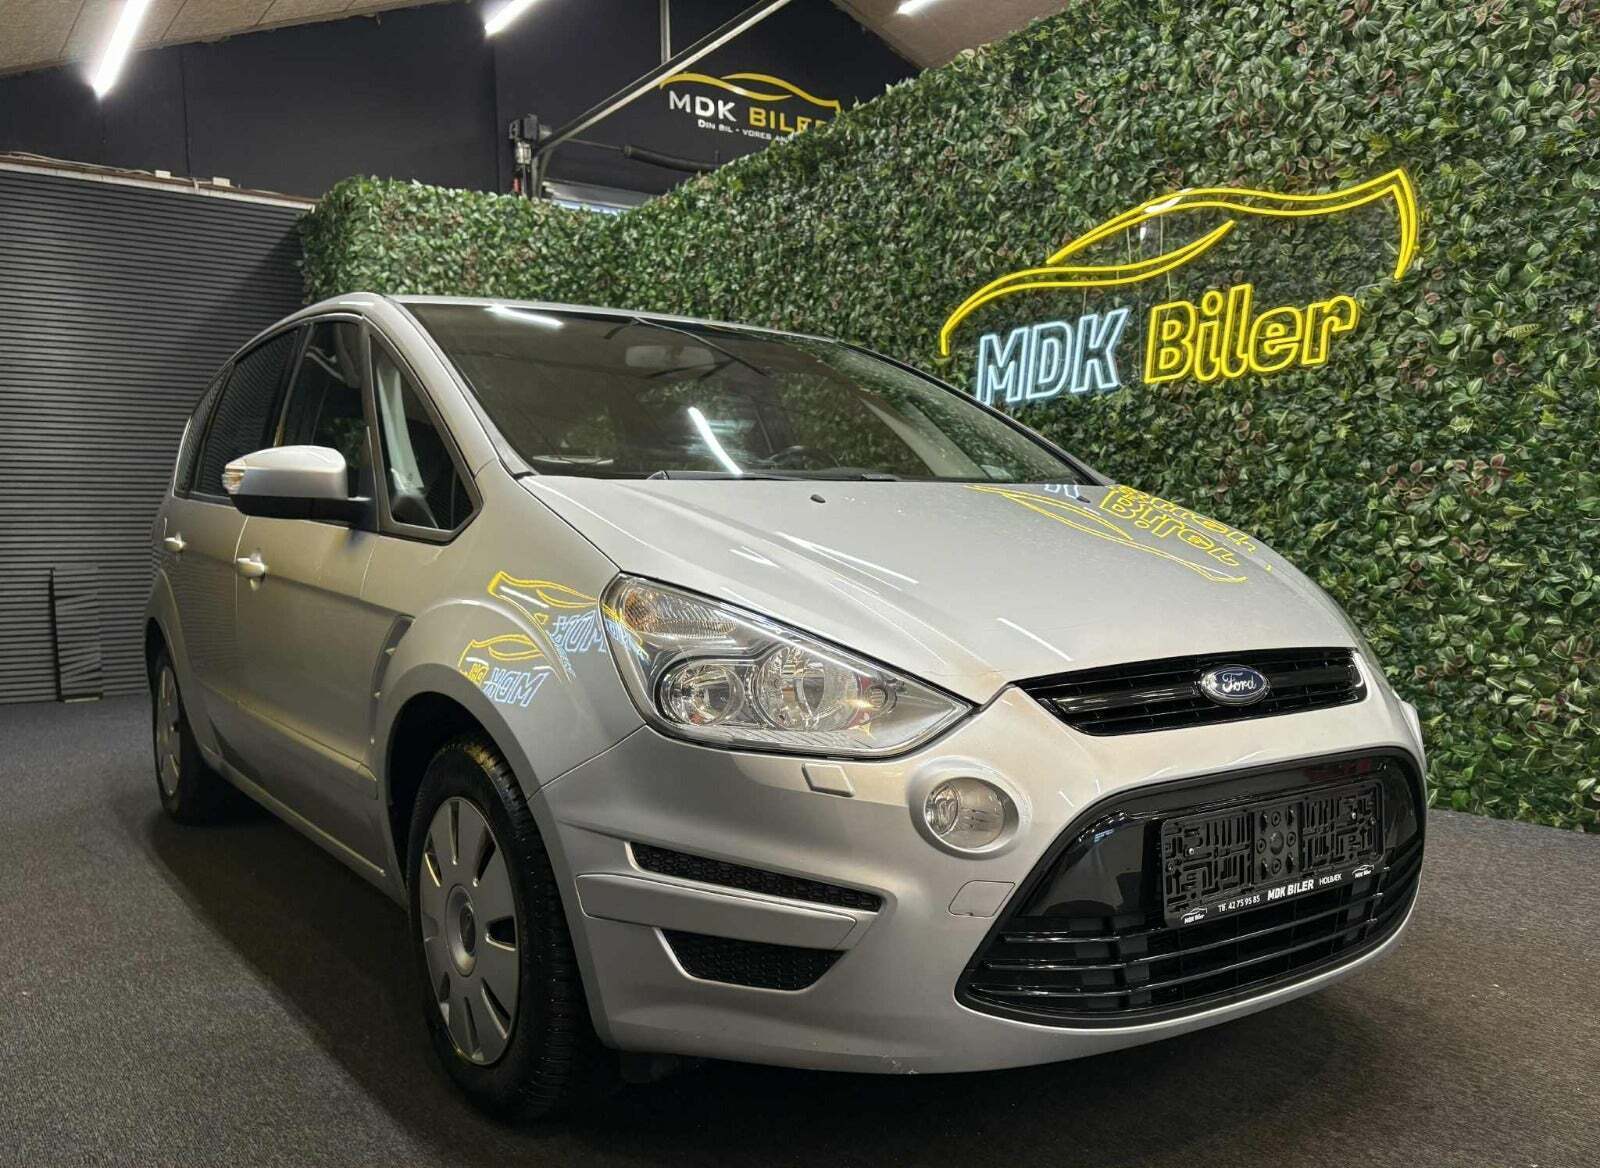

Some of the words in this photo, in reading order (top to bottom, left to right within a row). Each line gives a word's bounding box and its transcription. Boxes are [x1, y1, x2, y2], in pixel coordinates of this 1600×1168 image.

[668, 90, 736, 122] MDK
[749, 106, 827, 134] BILE
[976, 308, 1130, 406] MDK
[1144, 283, 1359, 384] Biler
[1222, 672, 1257, 693] Ford
[1228, 901, 1236, 909] 42
[1267, 886, 1286, 901] MDK
[1287, 879, 1314, 896] BILER
